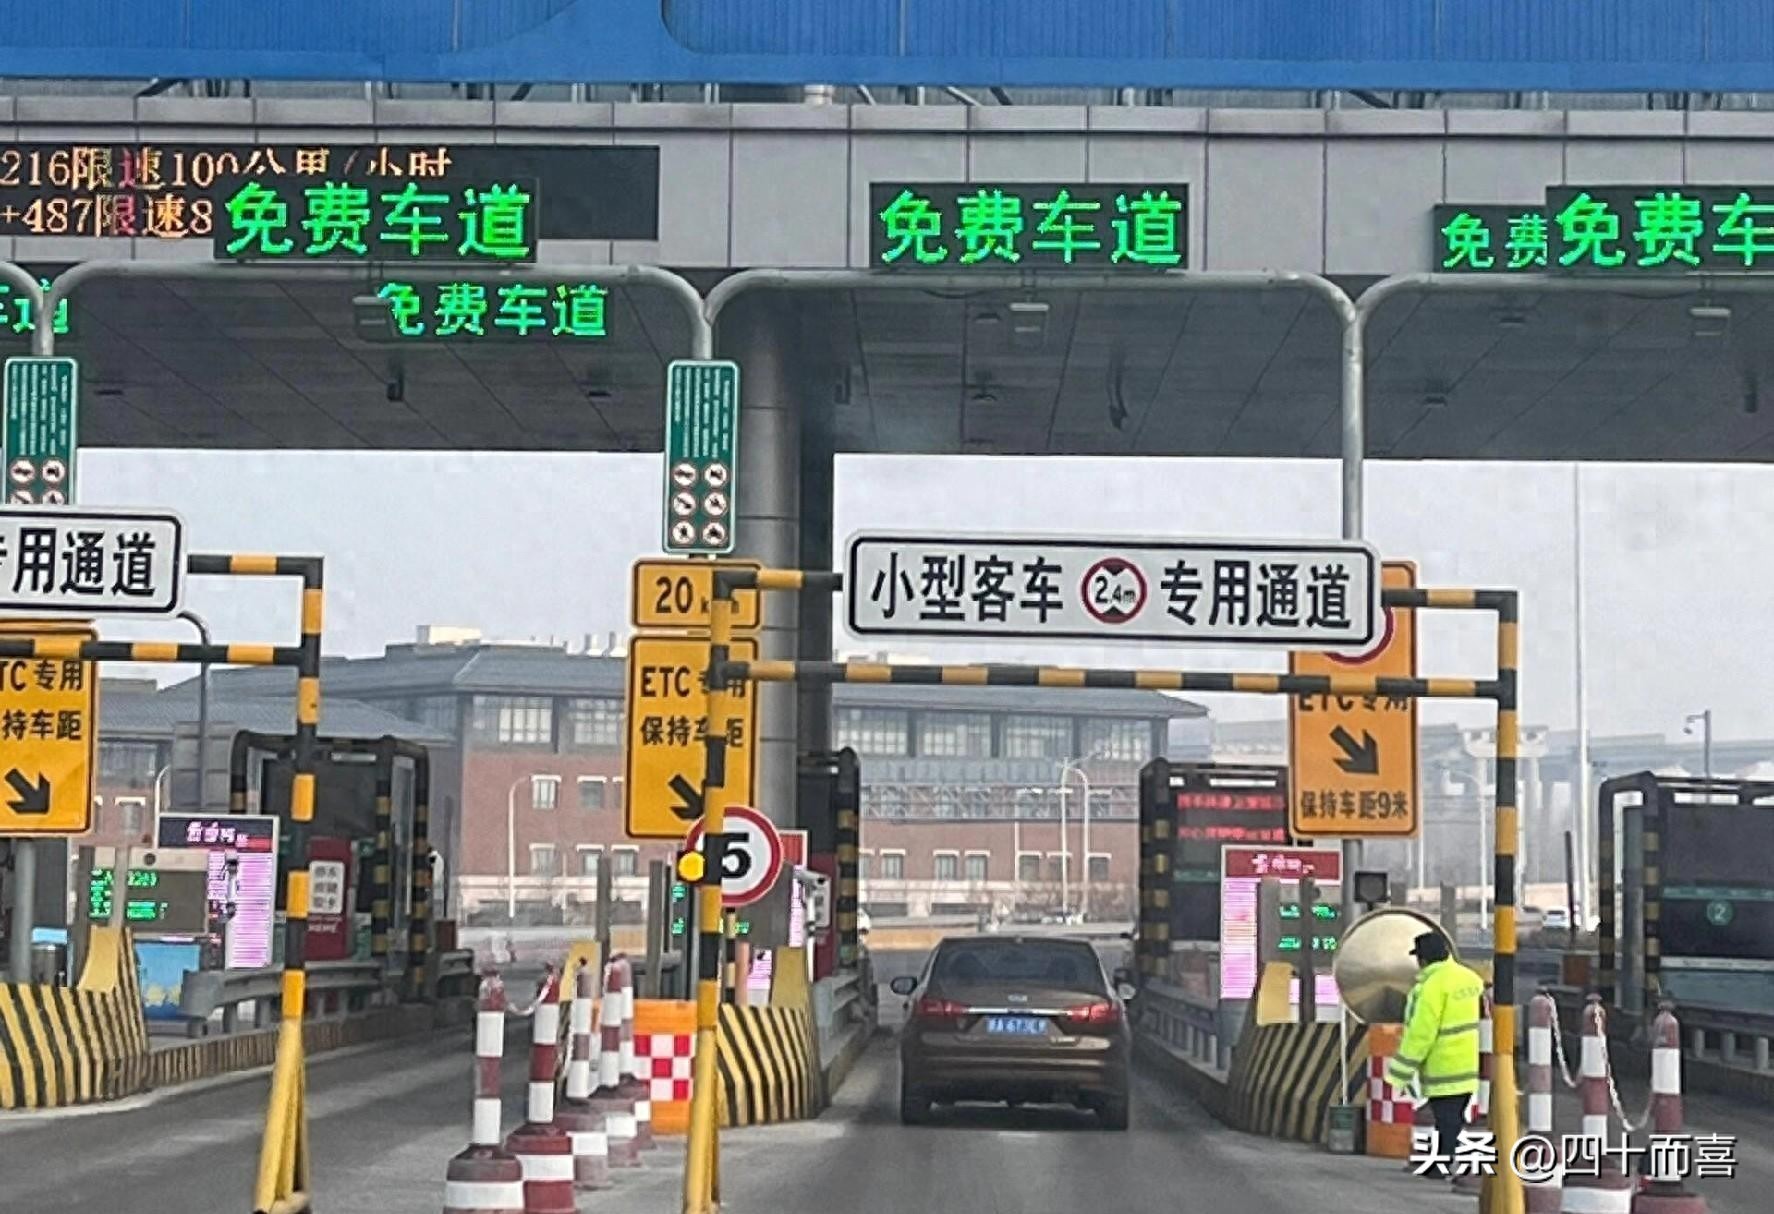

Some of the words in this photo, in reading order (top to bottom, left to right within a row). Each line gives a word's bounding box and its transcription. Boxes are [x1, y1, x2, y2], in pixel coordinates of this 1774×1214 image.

[225, 182, 530, 255] 免费车道
[880, 189, 1182, 263] 免费车道
[1441, 213, 1548, 268] 免费
[1554, 192, 1774, 266] 免费车
[377, 283, 608, 336] 免费车道
[655, 576, 693, 613] 20
[871, 552, 1063, 624] 小型客车
[1095, 575, 1136, 604] 2.4m
[1160, 559, 1351, 629] 专用通道
[1301, 790, 1408, 820] 保持车距9米
